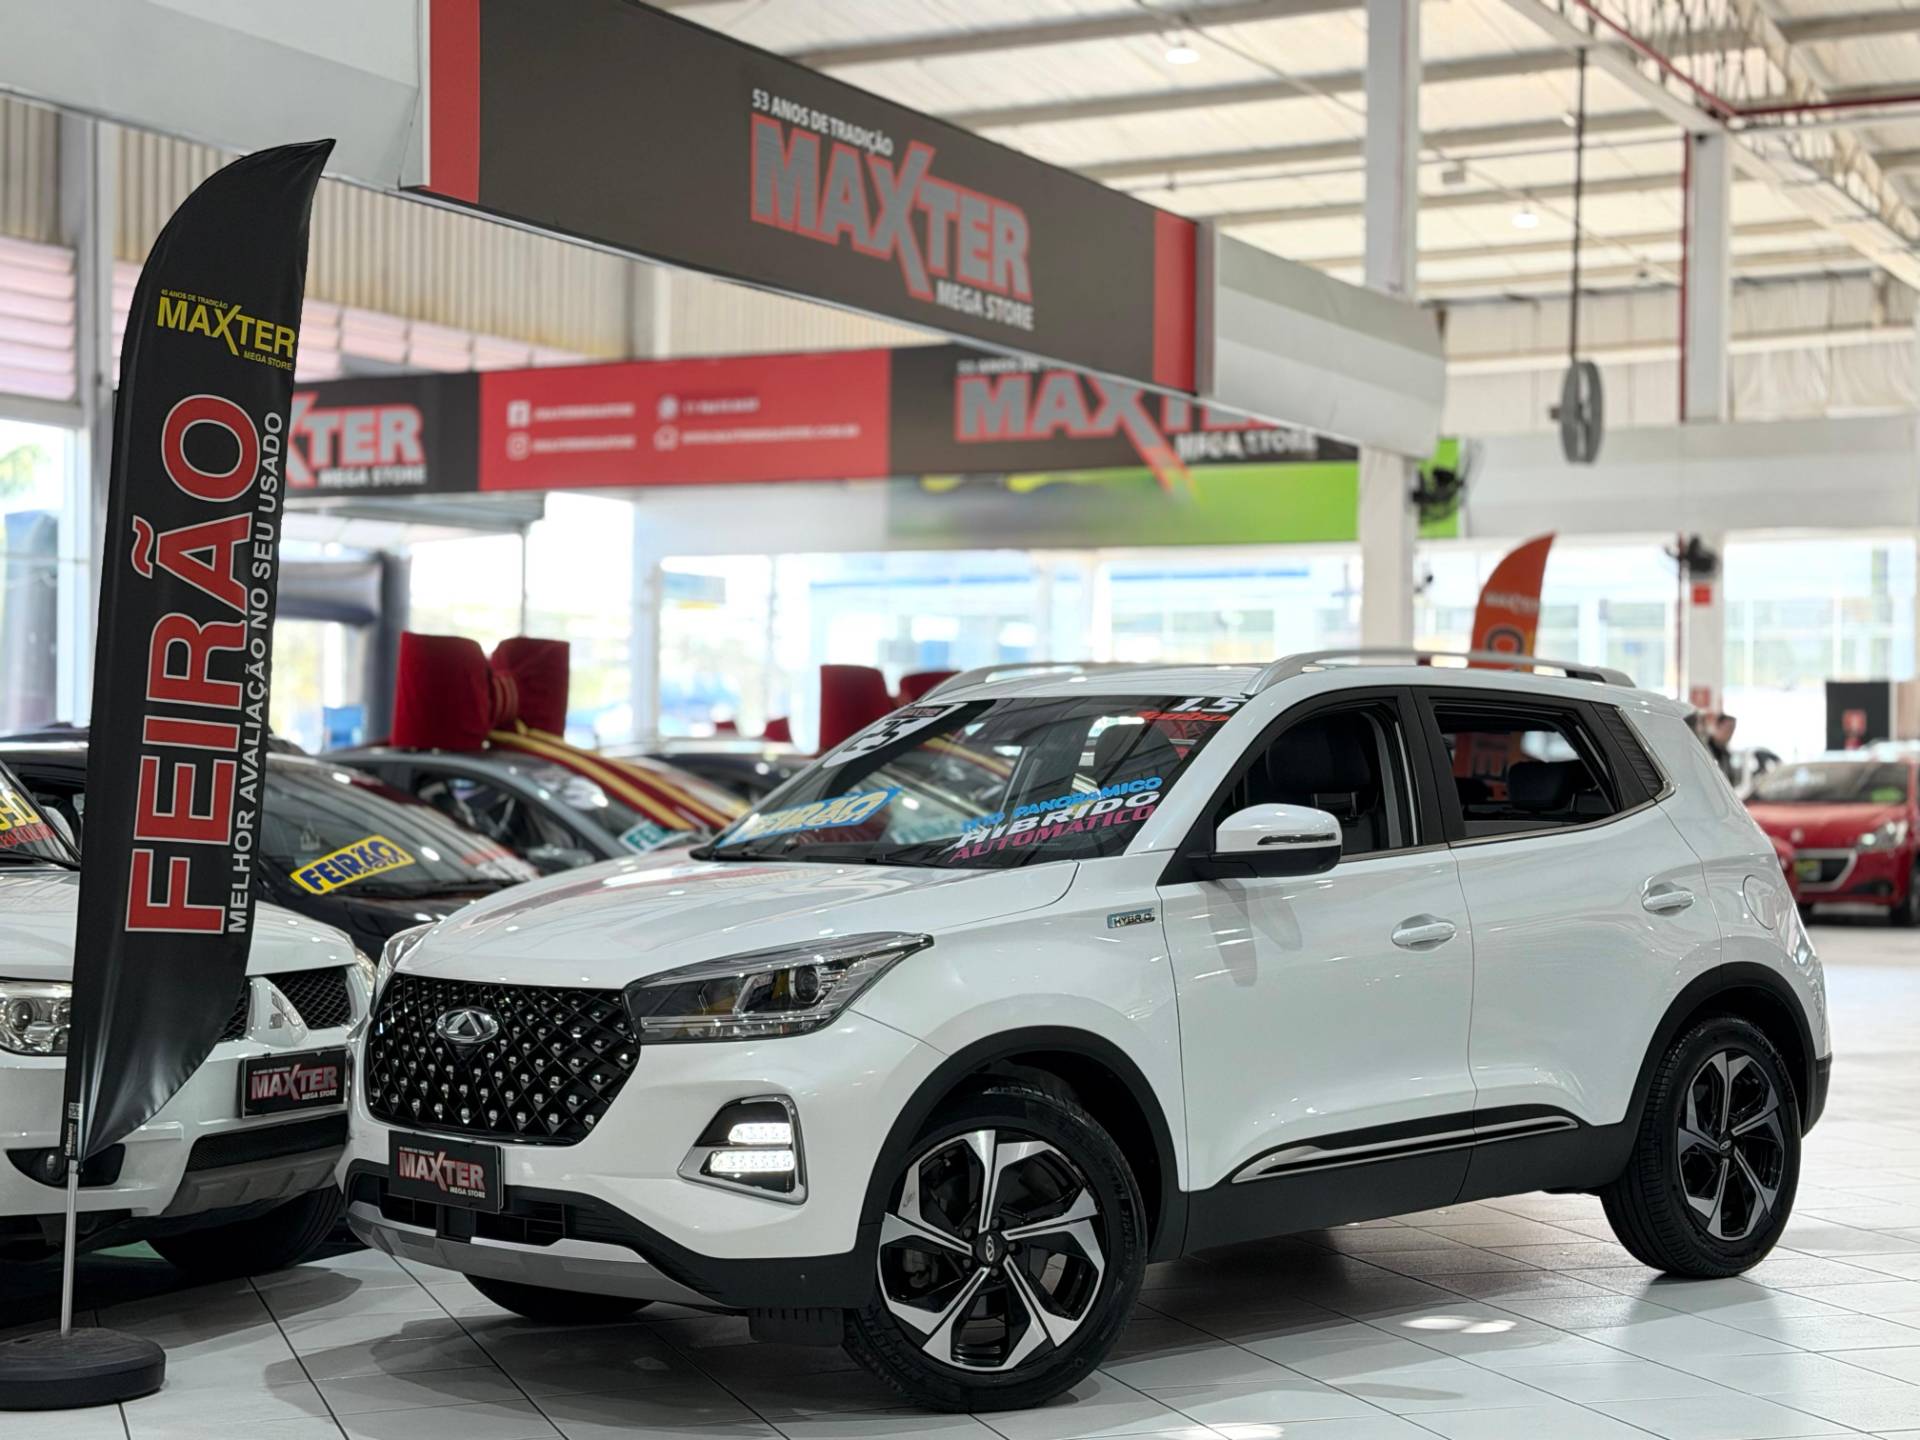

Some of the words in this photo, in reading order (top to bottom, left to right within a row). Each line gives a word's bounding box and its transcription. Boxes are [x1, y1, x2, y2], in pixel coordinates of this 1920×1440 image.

[752, 88, 770, 111] 53
[771, 96, 810, 127] ANOS
[810, 110, 830, 134] DE
[830, 117, 895, 156] TRADIÇÃO
[751, 112, 1033, 303] MAXTER
[168, 291, 187, 300] ANOS
[187, 294, 197, 302] DE
[197, 296, 229, 310] TRADIÇÃO
[935, 279, 983, 317] MEGA
[986, 296, 1035, 331] STORE
[157, 296, 297, 358] MAXTER
[243, 350, 267, 365] MEGA
[267, 356, 293, 372] STORE
[257, 412, 283, 513] USADO
[252, 526, 275, 579] SEU
[250, 588, 269, 629] NO
[125, 394, 261, 934] FEIRÃO
[240, 638, 268, 803] AVALIAÇÃO
[1171, 697, 1249, 712] 1.5
[948, 805, 1157, 863] AUTOMATICO
[228, 810, 255, 933] MELHOR
[298, 840, 402, 891] FEIRÃO
[251, 1063, 338, 1101] MAXTER
[398, 1151, 486, 1193] MAXTER
[449, 1186, 467, 1196] MEGA
[467, 1189, 486, 1199] STORE
